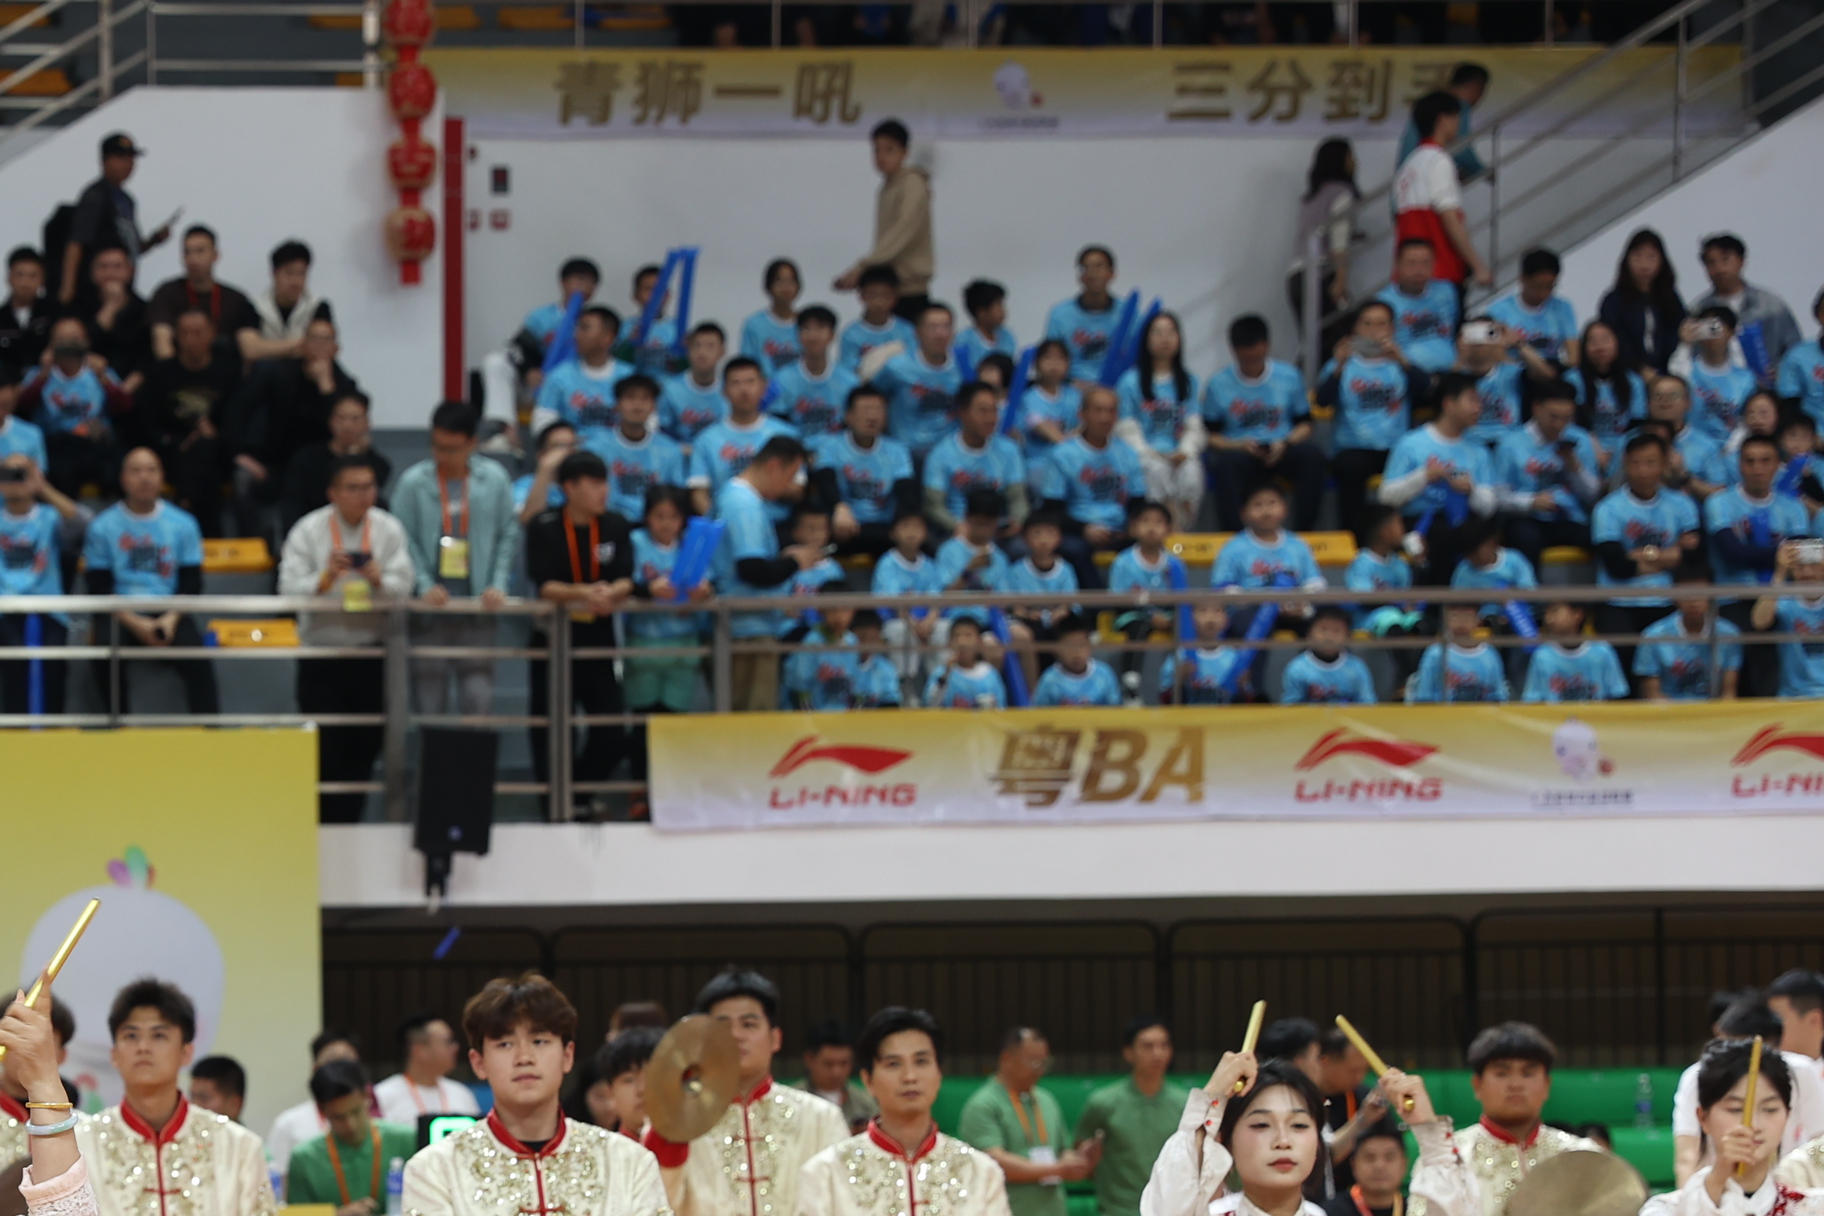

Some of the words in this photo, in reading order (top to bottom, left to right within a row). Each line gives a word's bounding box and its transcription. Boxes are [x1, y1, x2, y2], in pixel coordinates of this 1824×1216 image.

[554, 60, 863, 127] 青狮一吼
[768, 783, 918, 811] LI-NING
[1294, 777, 1443, 802] LI-NING
